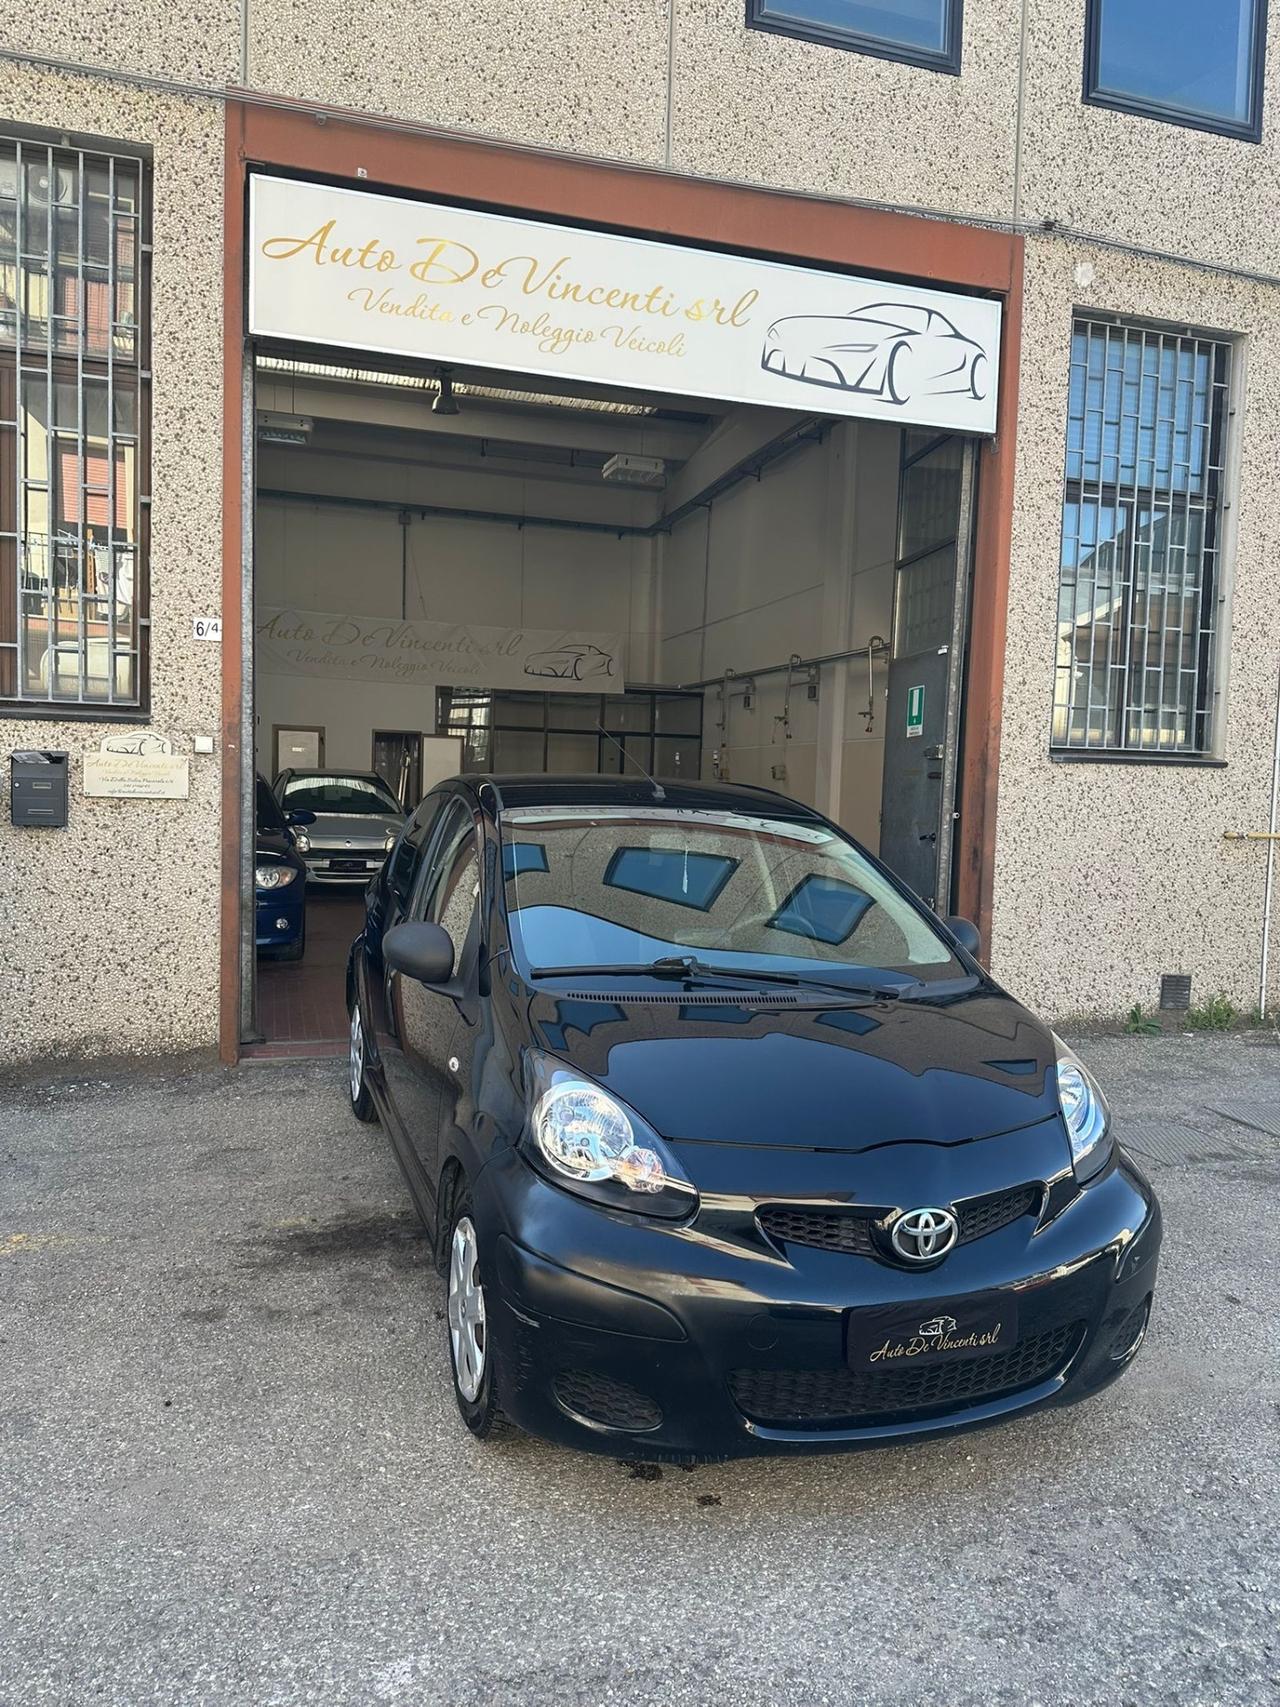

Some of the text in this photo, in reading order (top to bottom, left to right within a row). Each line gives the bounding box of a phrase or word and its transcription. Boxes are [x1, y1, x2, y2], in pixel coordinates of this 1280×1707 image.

[262, 220, 759, 327] Auto De Vincenti srl
[348, 287, 687, 357] Vendita e Noleggio Veicoli
[196, 621, 219, 637] 6/4
[256, 610, 314, 641] Auto
[870, 1323, 1001, 1362] Auto De Vincenti srl
